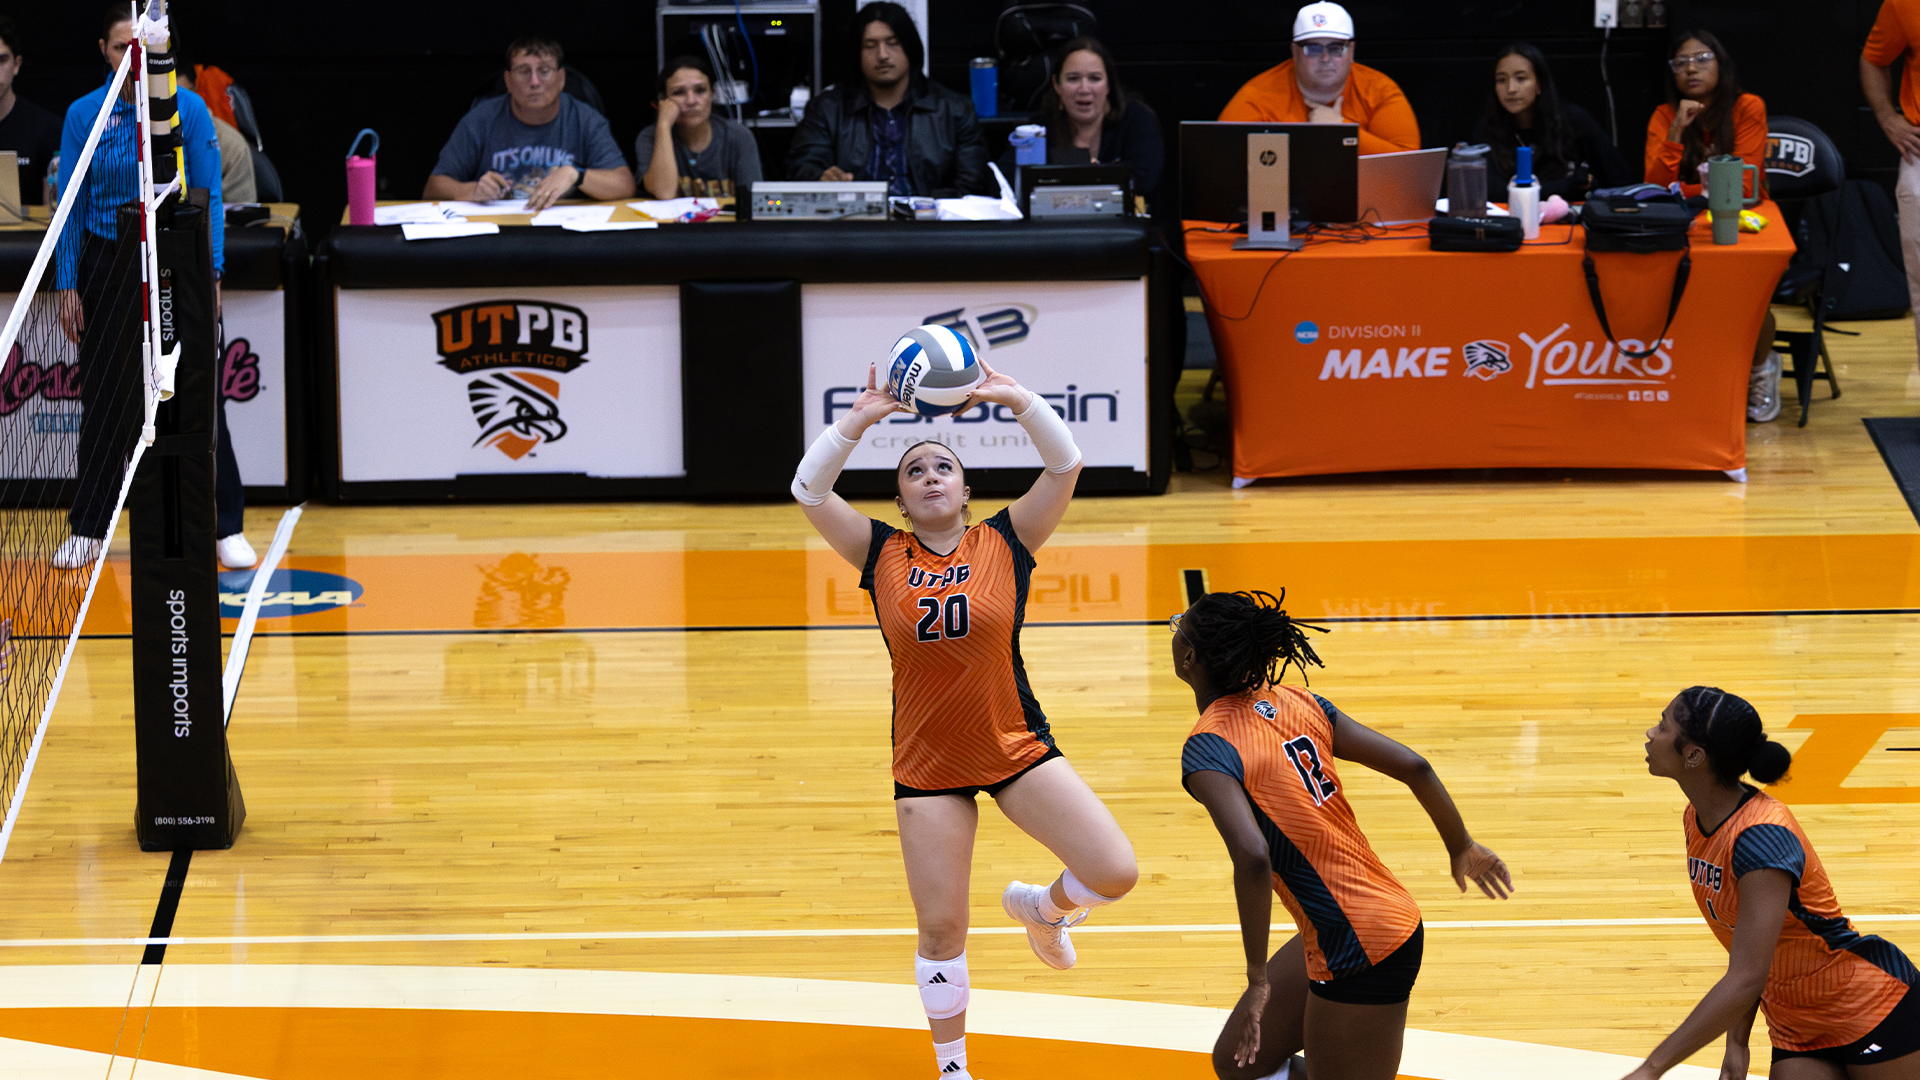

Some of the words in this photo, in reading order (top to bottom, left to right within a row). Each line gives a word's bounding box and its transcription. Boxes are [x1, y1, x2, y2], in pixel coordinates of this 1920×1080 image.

[1765, 138, 1809, 164] TPB
[439, 305, 583, 354] UTPB
[1328, 325, 1406, 340] DIVISION
[1411, 325, 1421, 337] II
[460, 352, 567, 370] ATHLETICS
[1318, 347, 1452, 381] MAKE
[902, 362, 922, 407] molten
[908, 564, 970, 588] UTPB
[167, 589, 189, 655] sports
[916, 593, 969, 642] 20
[169, 658, 192, 738] imports
[1282, 735, 1337, 807] 12
[155, 816, 176, 825] (800)
[178, 816, 215, 825] 556-3198
[1689, 856, 1723, 892] UTPB
